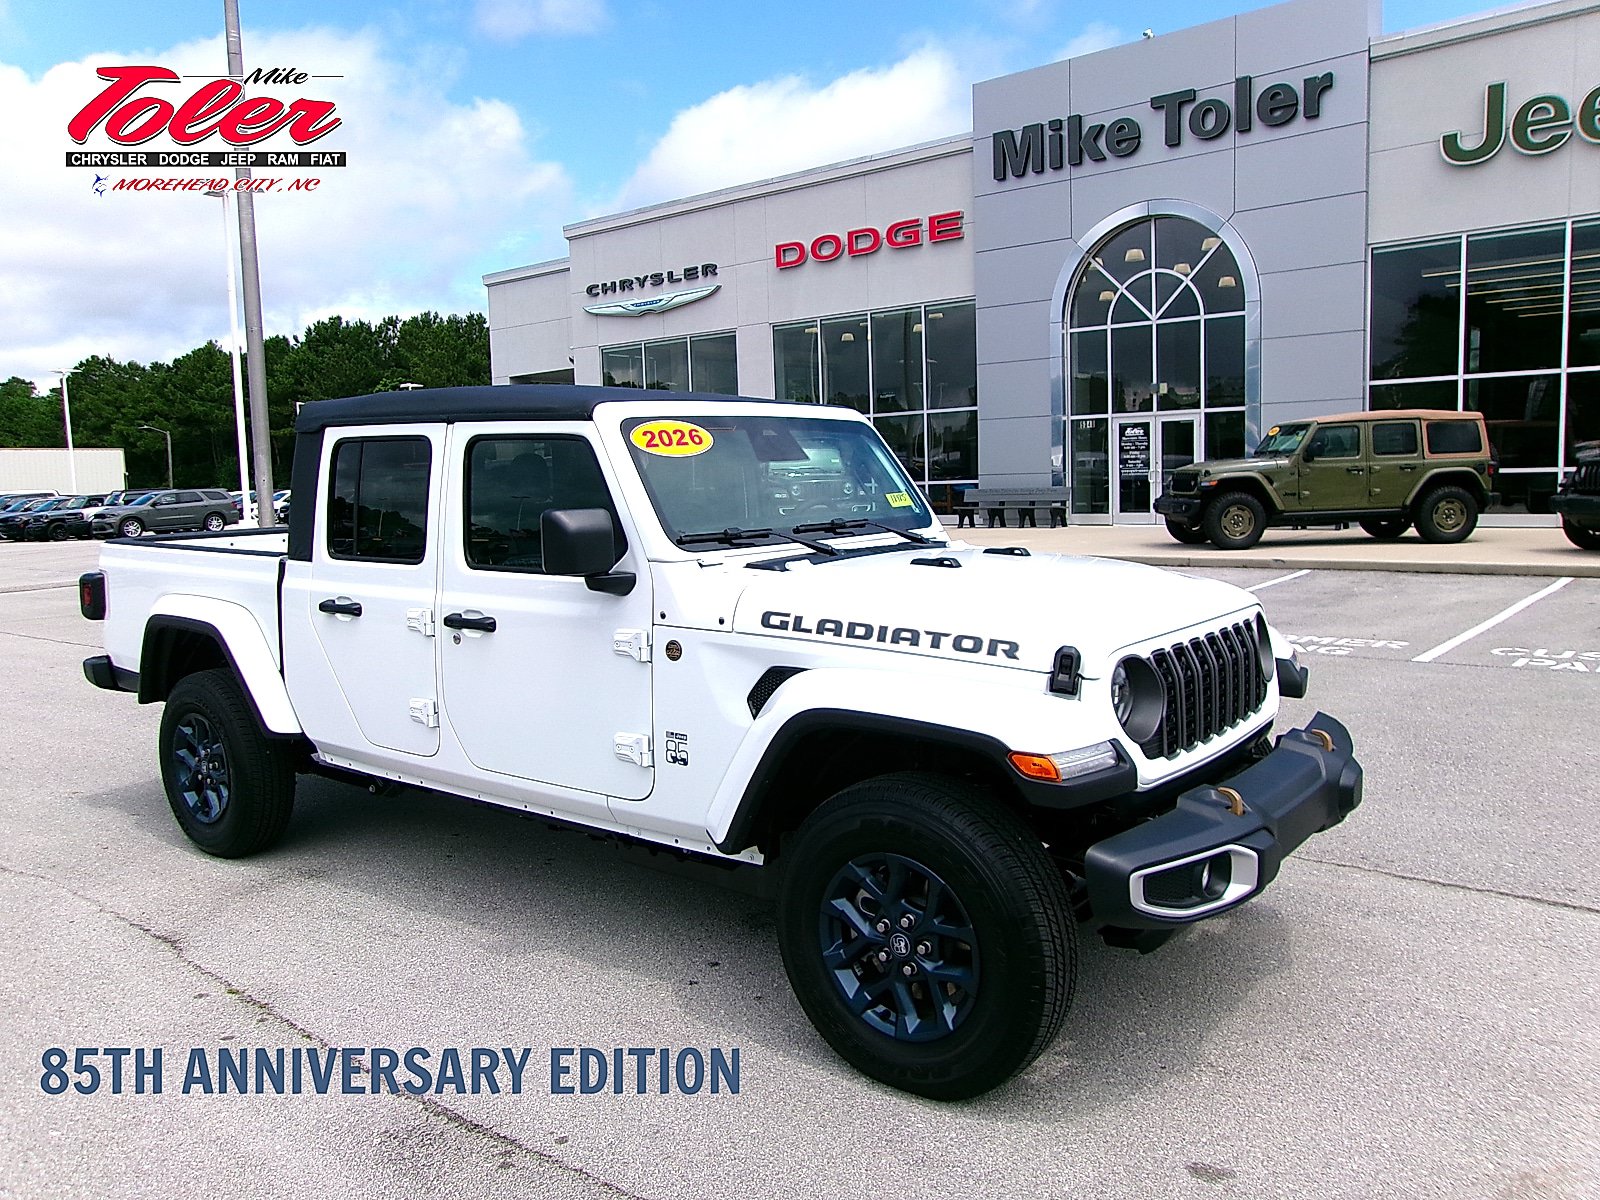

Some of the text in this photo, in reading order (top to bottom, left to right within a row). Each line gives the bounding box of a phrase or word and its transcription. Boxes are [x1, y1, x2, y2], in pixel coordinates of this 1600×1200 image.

[992, 71, 1333, 182] Mike Toler
[775, 210, 965, 270] DODGE
[586, 262, 719, 297] CHRYSLER
[641, 429, 704, 449] 2026
[760, 610, 1020, 660] GLADIATOR
[666, 739, 688, 766] 85
